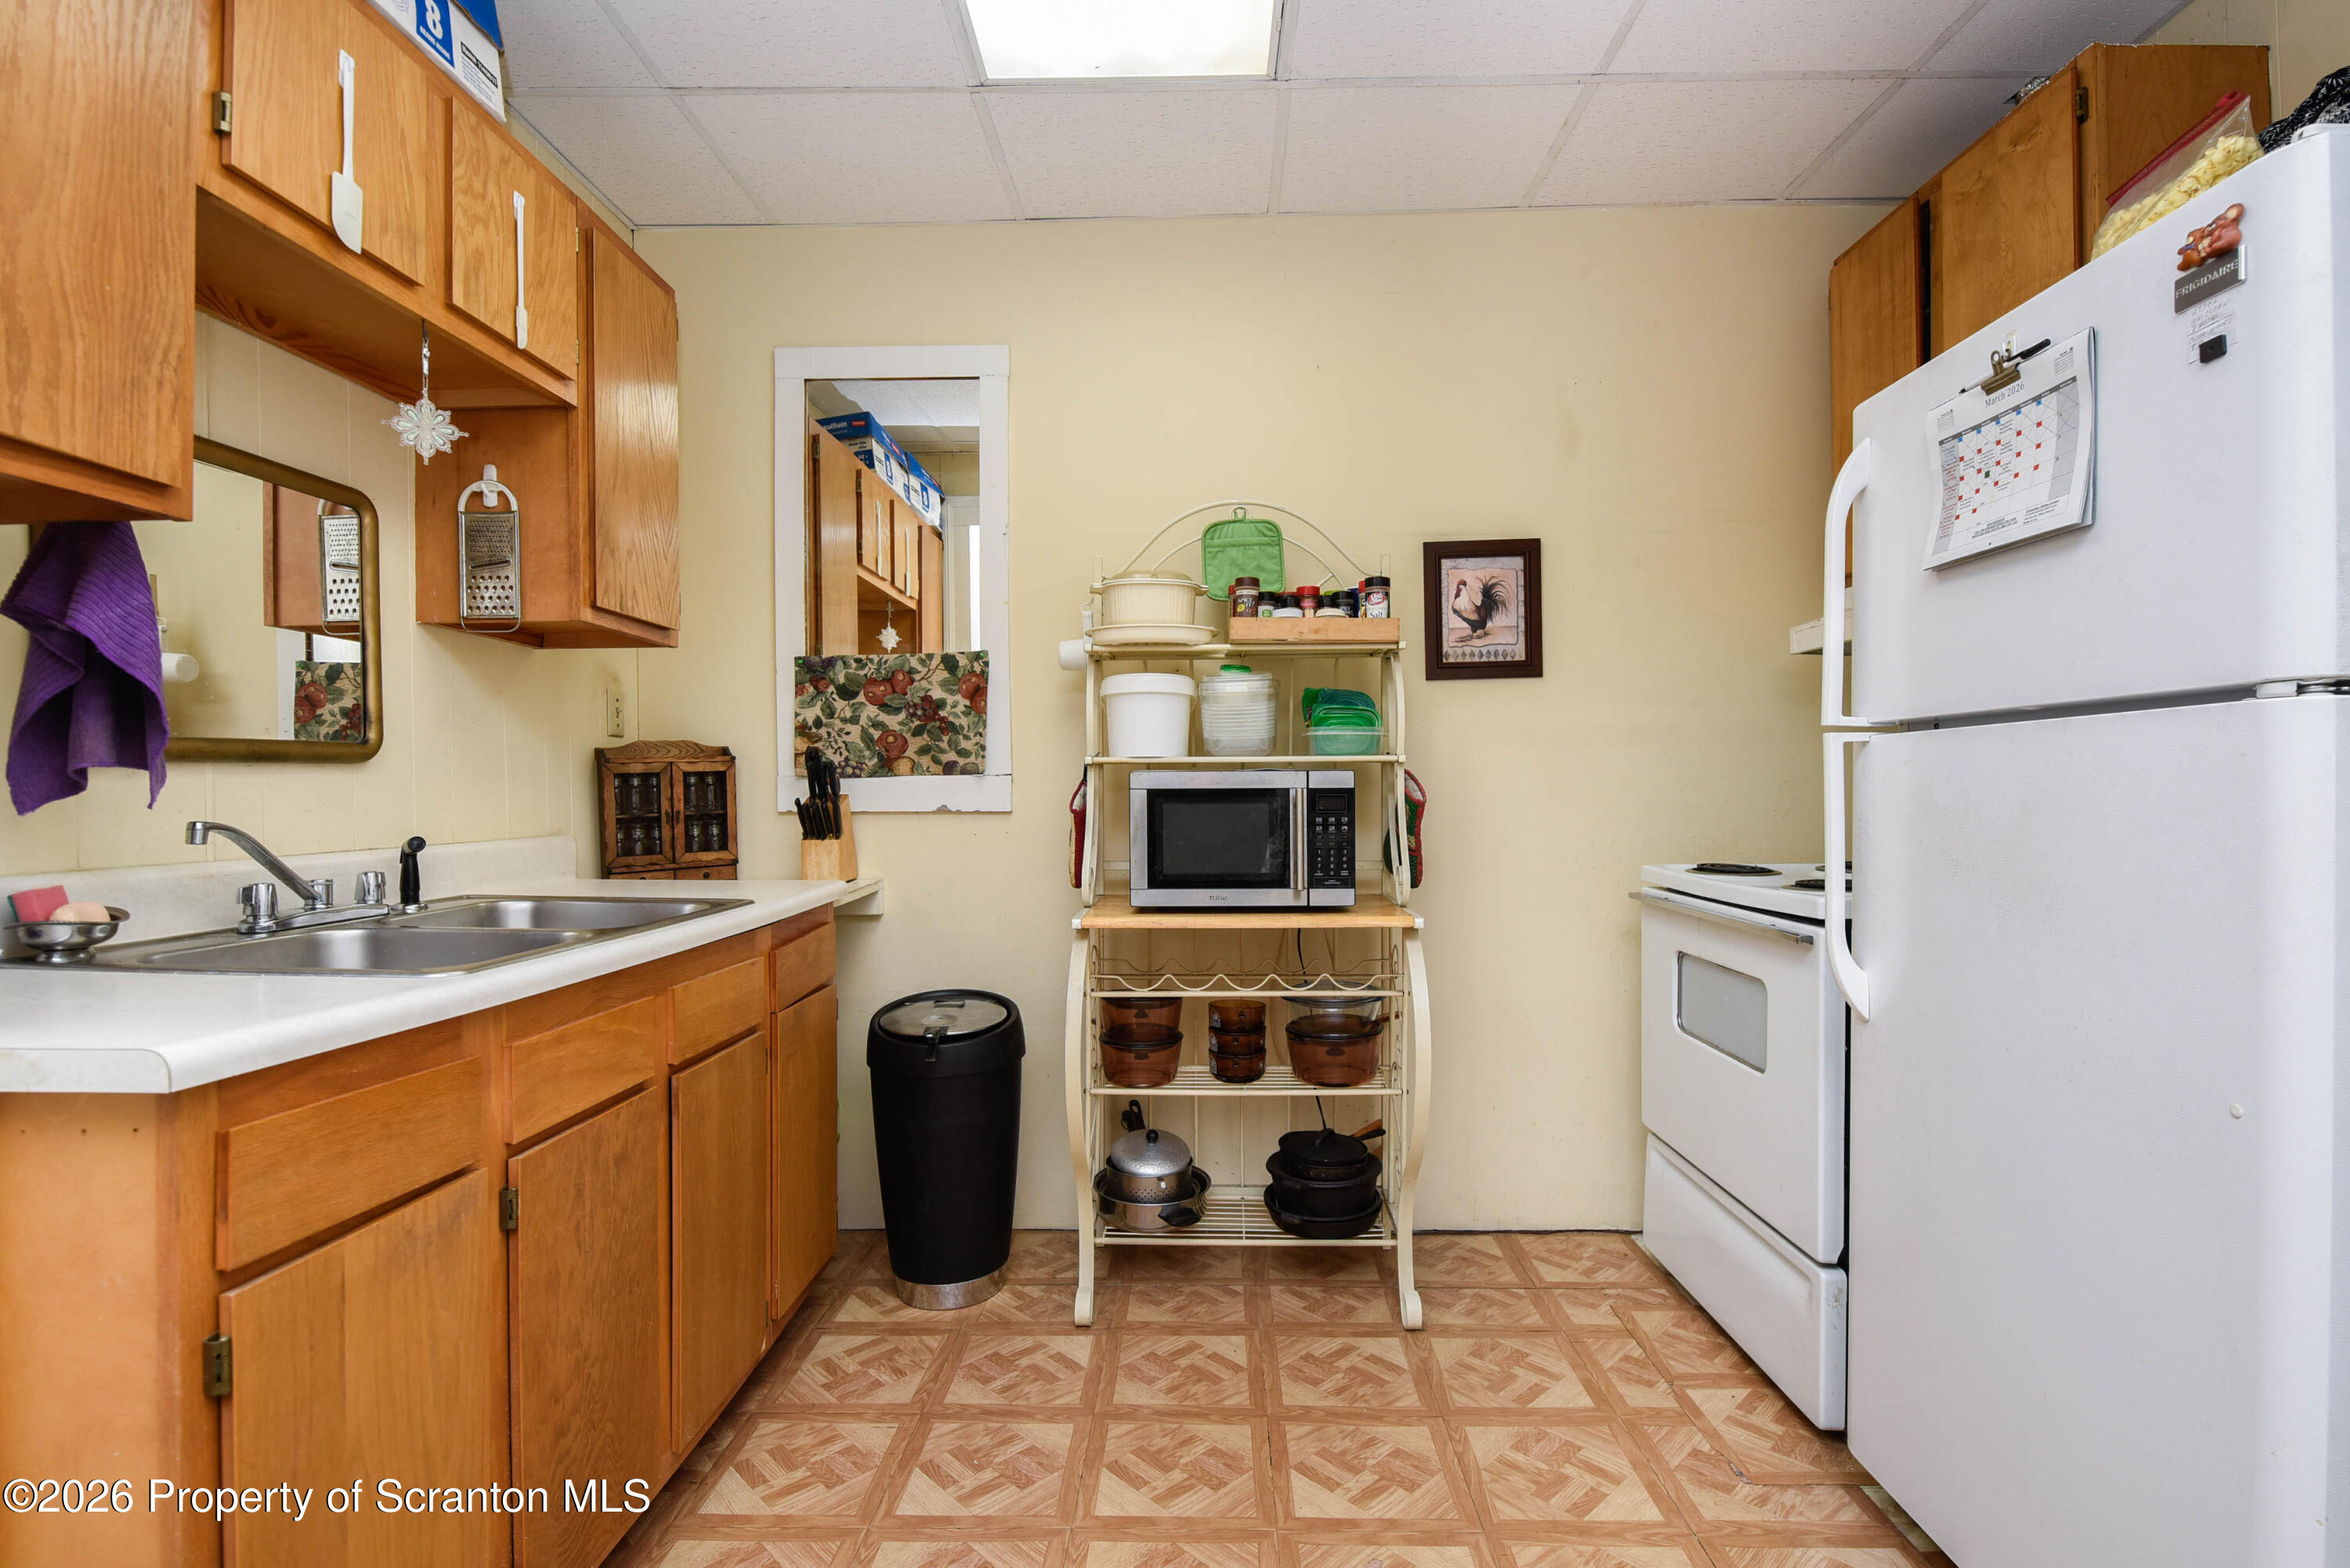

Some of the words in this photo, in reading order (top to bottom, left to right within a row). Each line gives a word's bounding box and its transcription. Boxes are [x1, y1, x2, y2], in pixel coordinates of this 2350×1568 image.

[2175, 259, 2239, 299] FRIGIDAIRE
[1985, 393, 2006, 408] March
[2007, 383, 2025, 398] 2026
